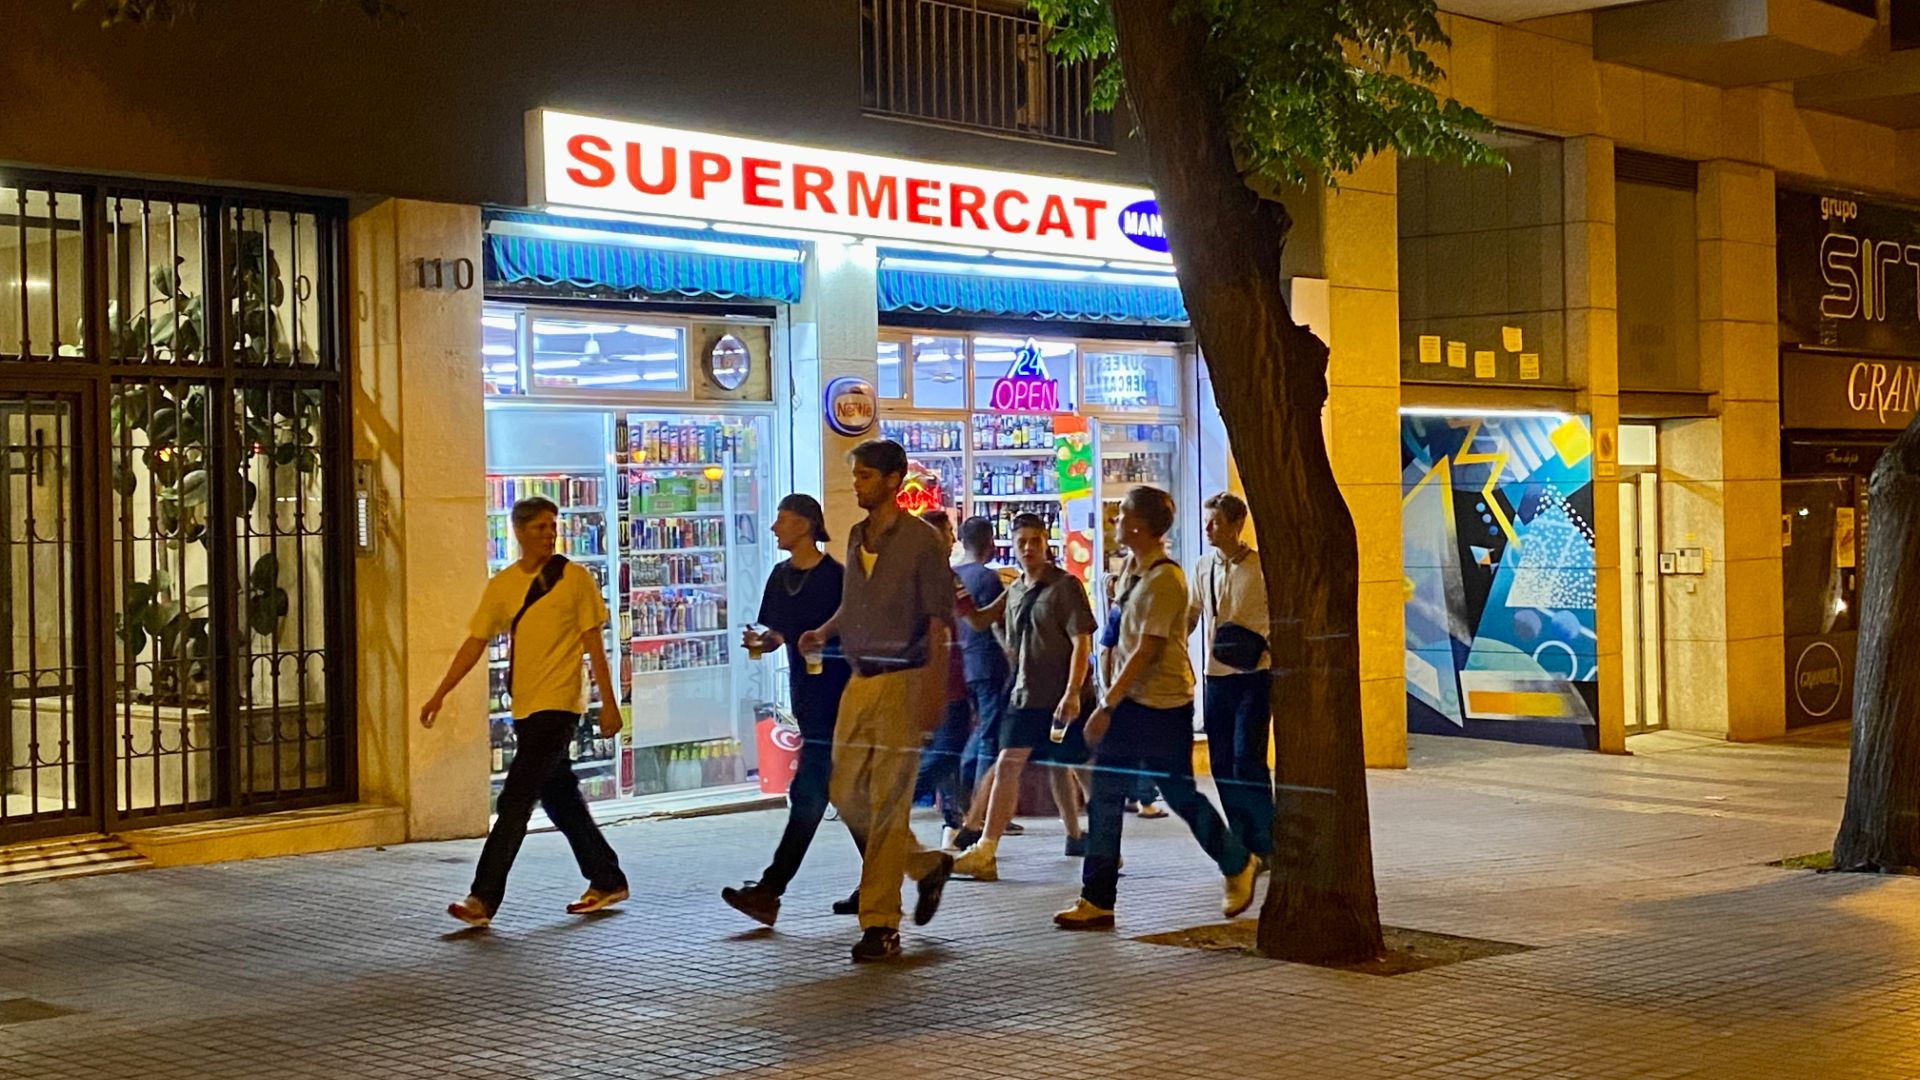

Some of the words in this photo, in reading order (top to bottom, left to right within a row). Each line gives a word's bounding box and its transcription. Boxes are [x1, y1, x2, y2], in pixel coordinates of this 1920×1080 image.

[566, 134, 1107, 240] SUPERMERCAT
[1124, 210, 1167, 239] MAN
[1820, 196, 1858, 223] grupo
[414, 257, 474, 290] 110
[1016, 350, 1042, 377] 24
[995, 380, 1059, 411] OPEN
